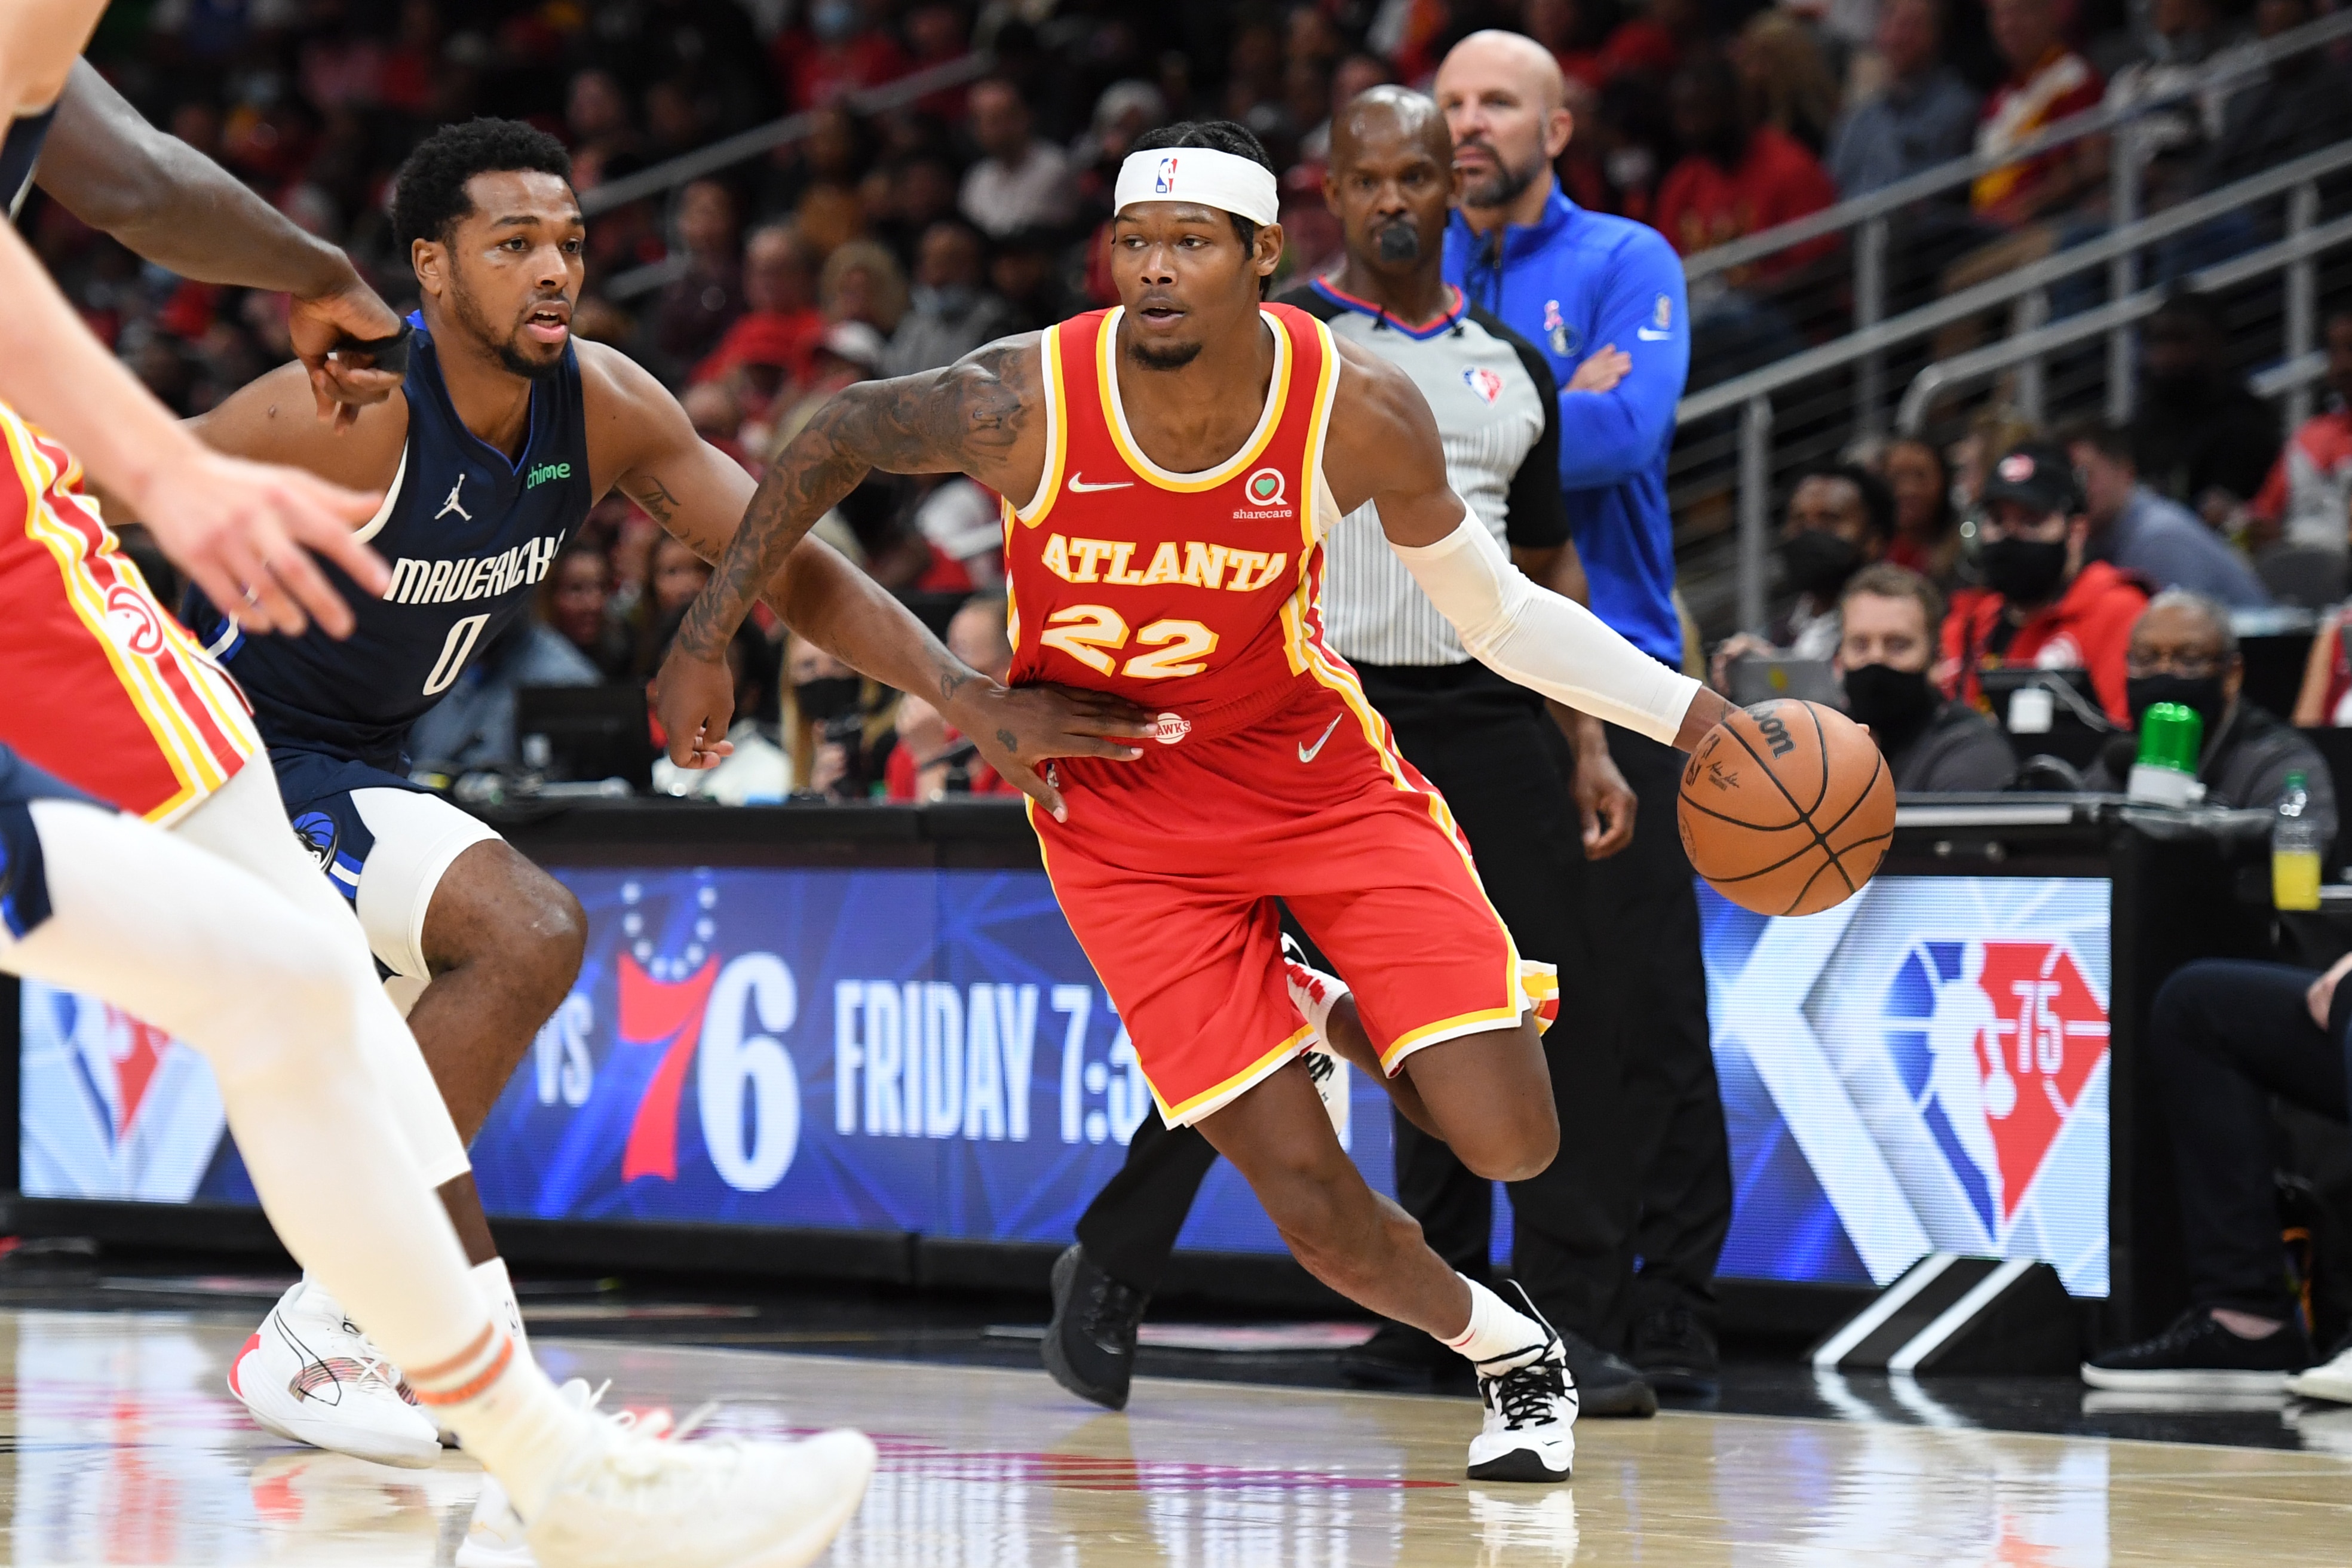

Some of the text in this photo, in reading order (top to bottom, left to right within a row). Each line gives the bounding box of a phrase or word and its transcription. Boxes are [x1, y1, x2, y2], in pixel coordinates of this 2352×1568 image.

[527, 462, 571, 489] chime
[1232, 509, 1292, 519] sharecare
[1041, 532, 1287, 592] ATLANTA
[422, 613, 490, 696] 0
[1040, 604, 1219, 679] 22
[1157, 721, 1190, 736] AWKS
[835, 979, 1039, 1142] FRIDAY
[2010, 980, 2063, 1074] 75
